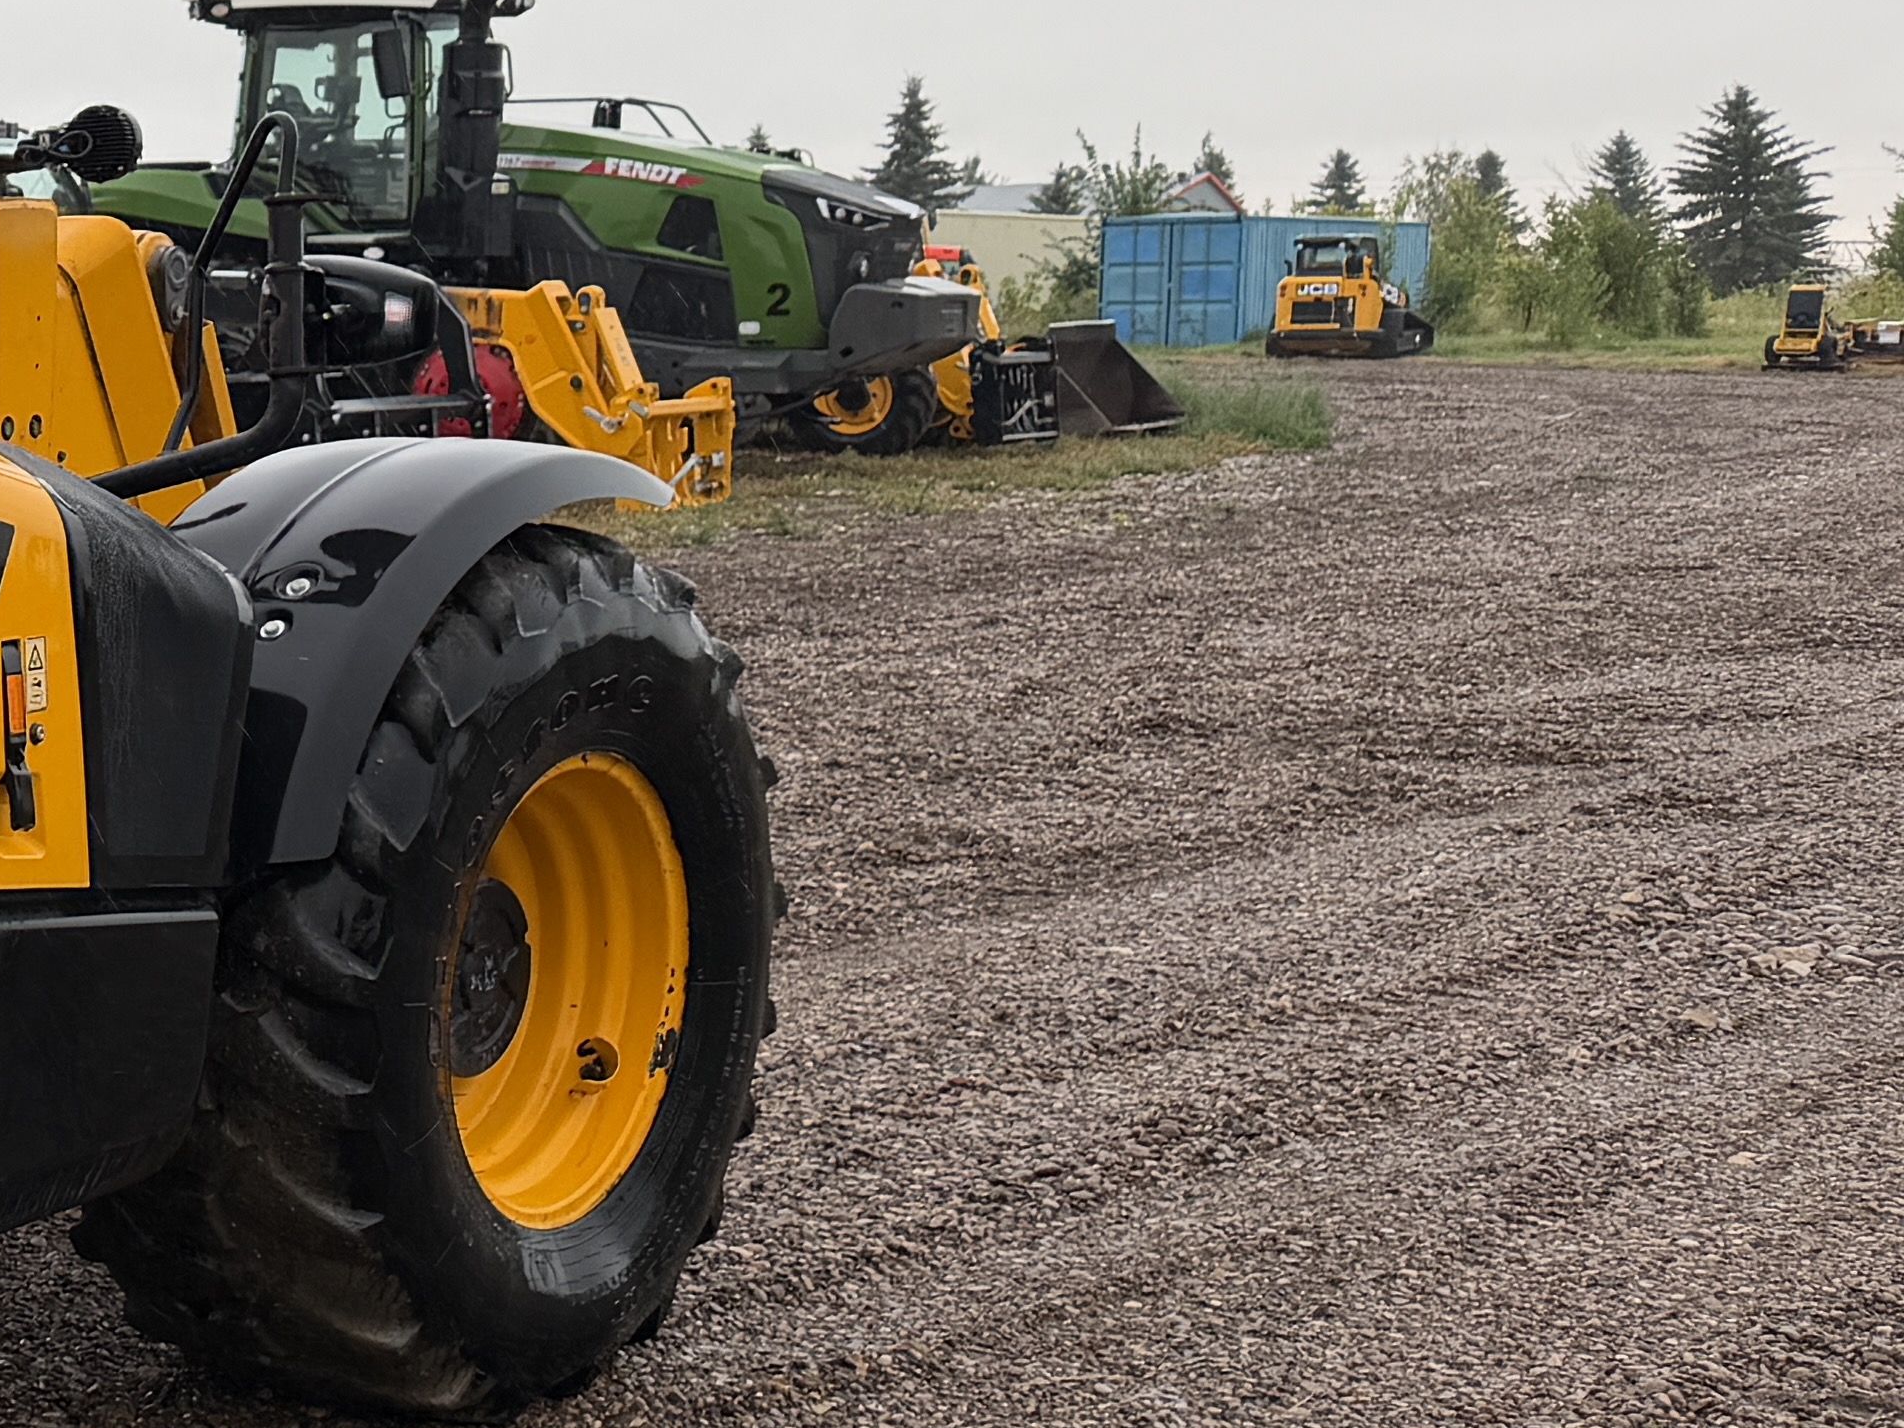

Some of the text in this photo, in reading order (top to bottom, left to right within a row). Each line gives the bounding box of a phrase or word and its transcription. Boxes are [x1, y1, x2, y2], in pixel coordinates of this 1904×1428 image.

[604, 157, 687, 185] FENDT
[766, 282, 791, 316] 2
[1297, 283, 1338, 296] JCB
